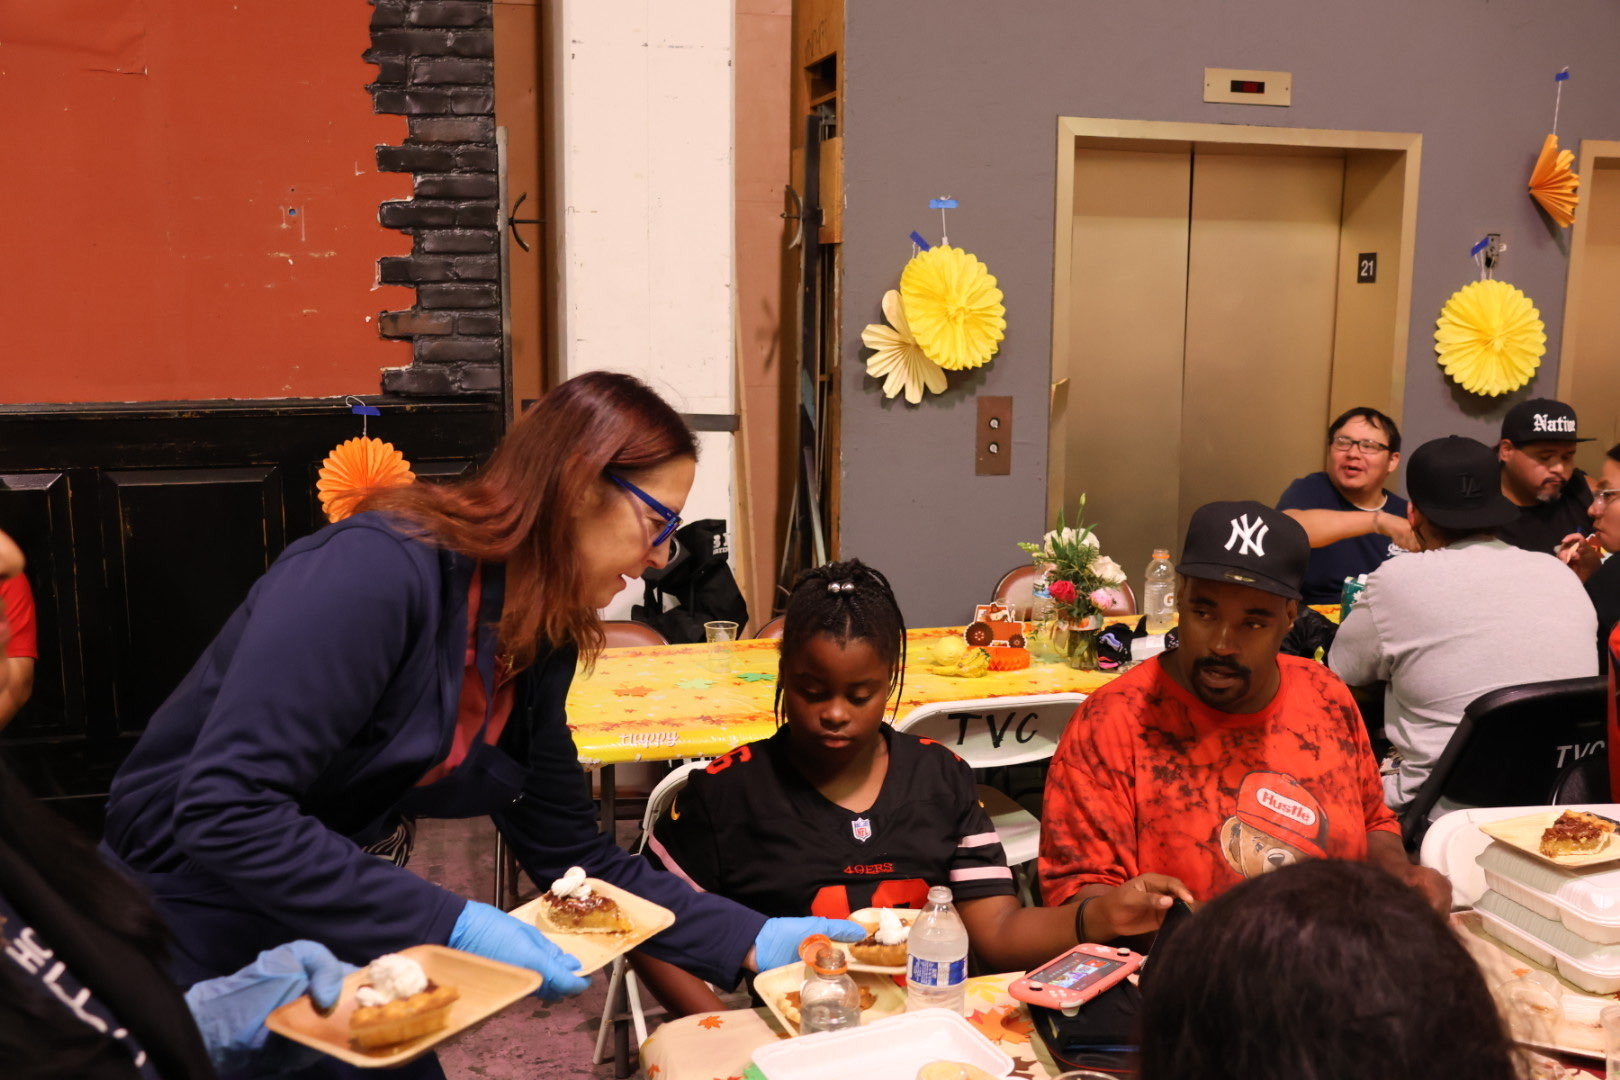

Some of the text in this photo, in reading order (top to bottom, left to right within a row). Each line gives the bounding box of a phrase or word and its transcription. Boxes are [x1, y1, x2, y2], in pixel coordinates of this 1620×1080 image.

[1360, 259, 1374, 277] 21
[1224, 513, 1269, 558] NY
[1163, 592, 1175, 607] G
[947, 711, 1039, 748] TVC
[1261, 791, 1310, 822] Hustle
[843, 862, 894, 875] 49ERS
